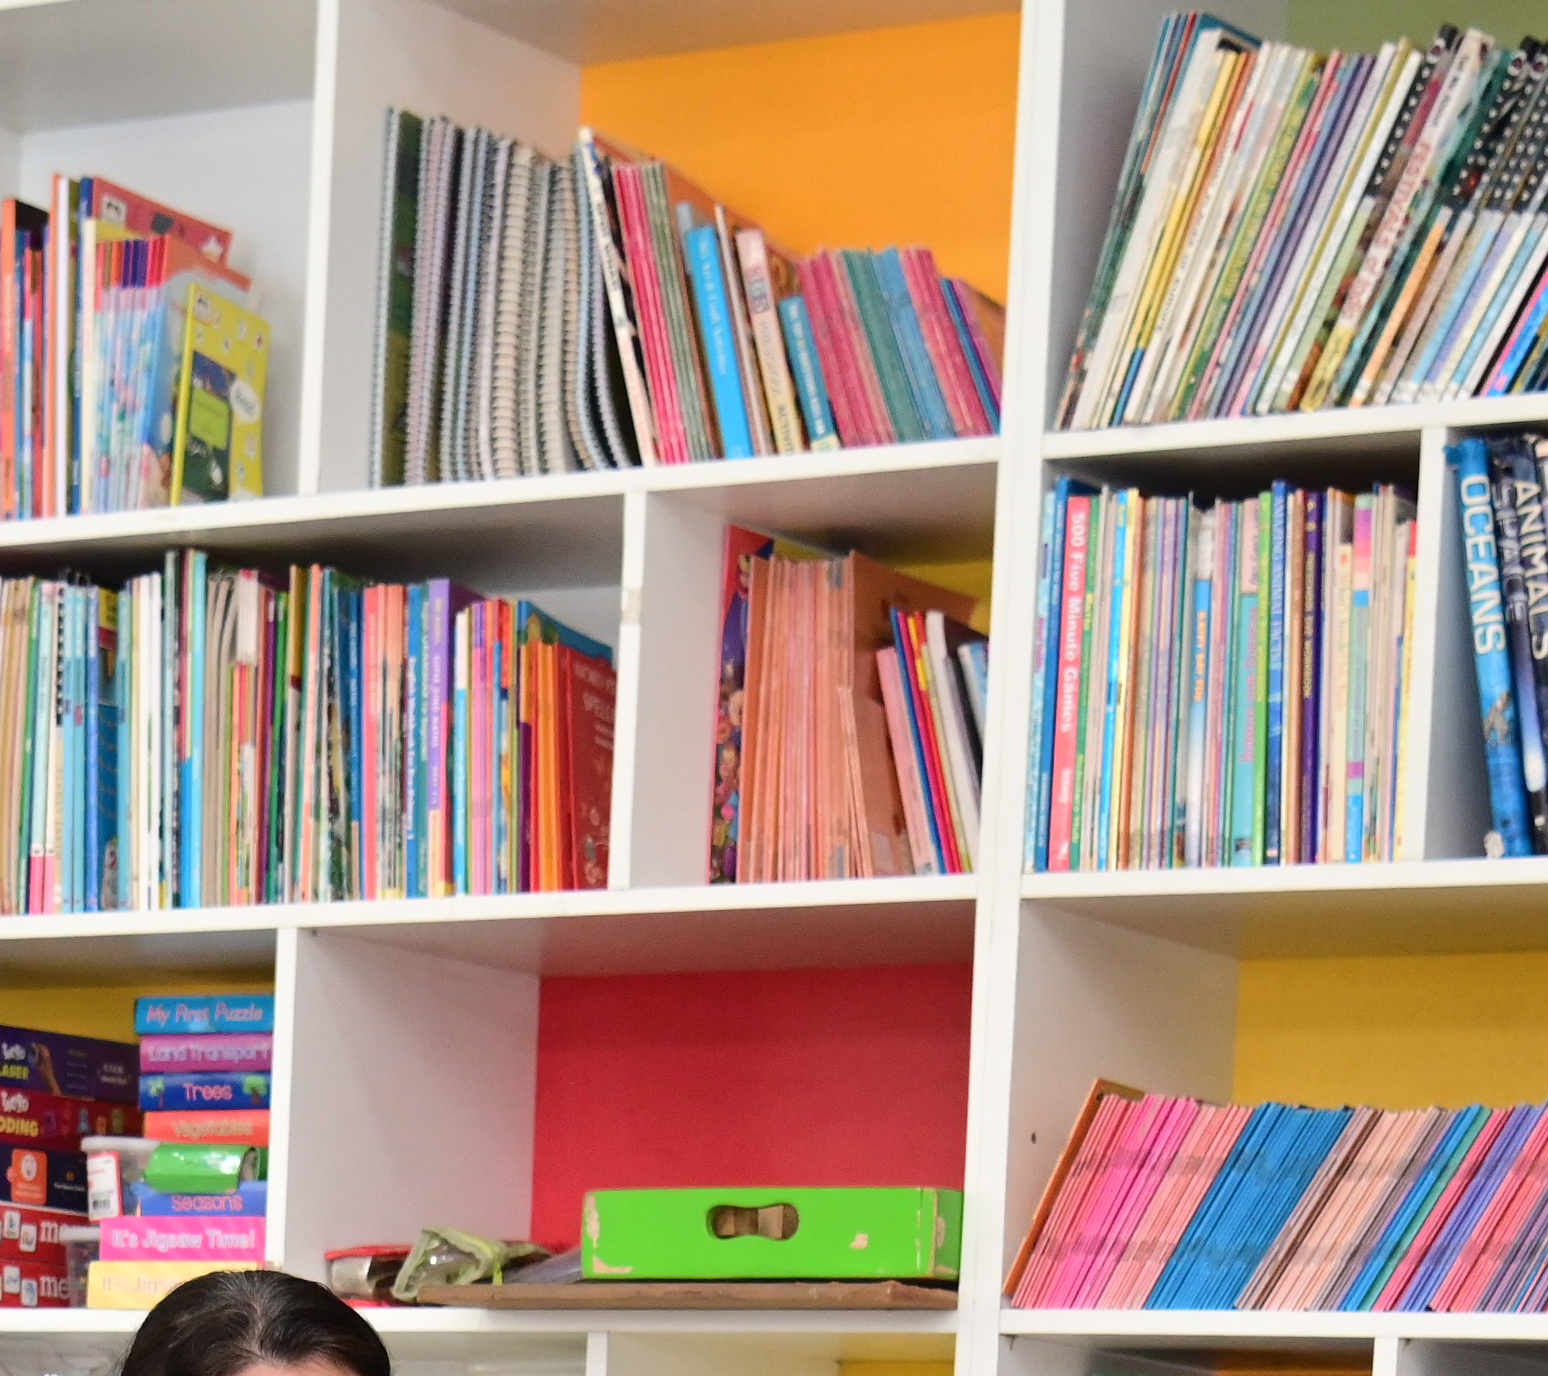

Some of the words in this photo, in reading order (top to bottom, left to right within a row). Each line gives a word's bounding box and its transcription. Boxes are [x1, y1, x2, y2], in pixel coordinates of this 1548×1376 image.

[1068, 512, 1087, 548] 500
[1065, 552, 1085, 592] Five
[1460, 473, 1506, 655] OCEANS
[1062, 595, 1083, 662] Minute
[1058, 668, 1078, 734] Games
[183, 1083, 233, 1100] Trees
